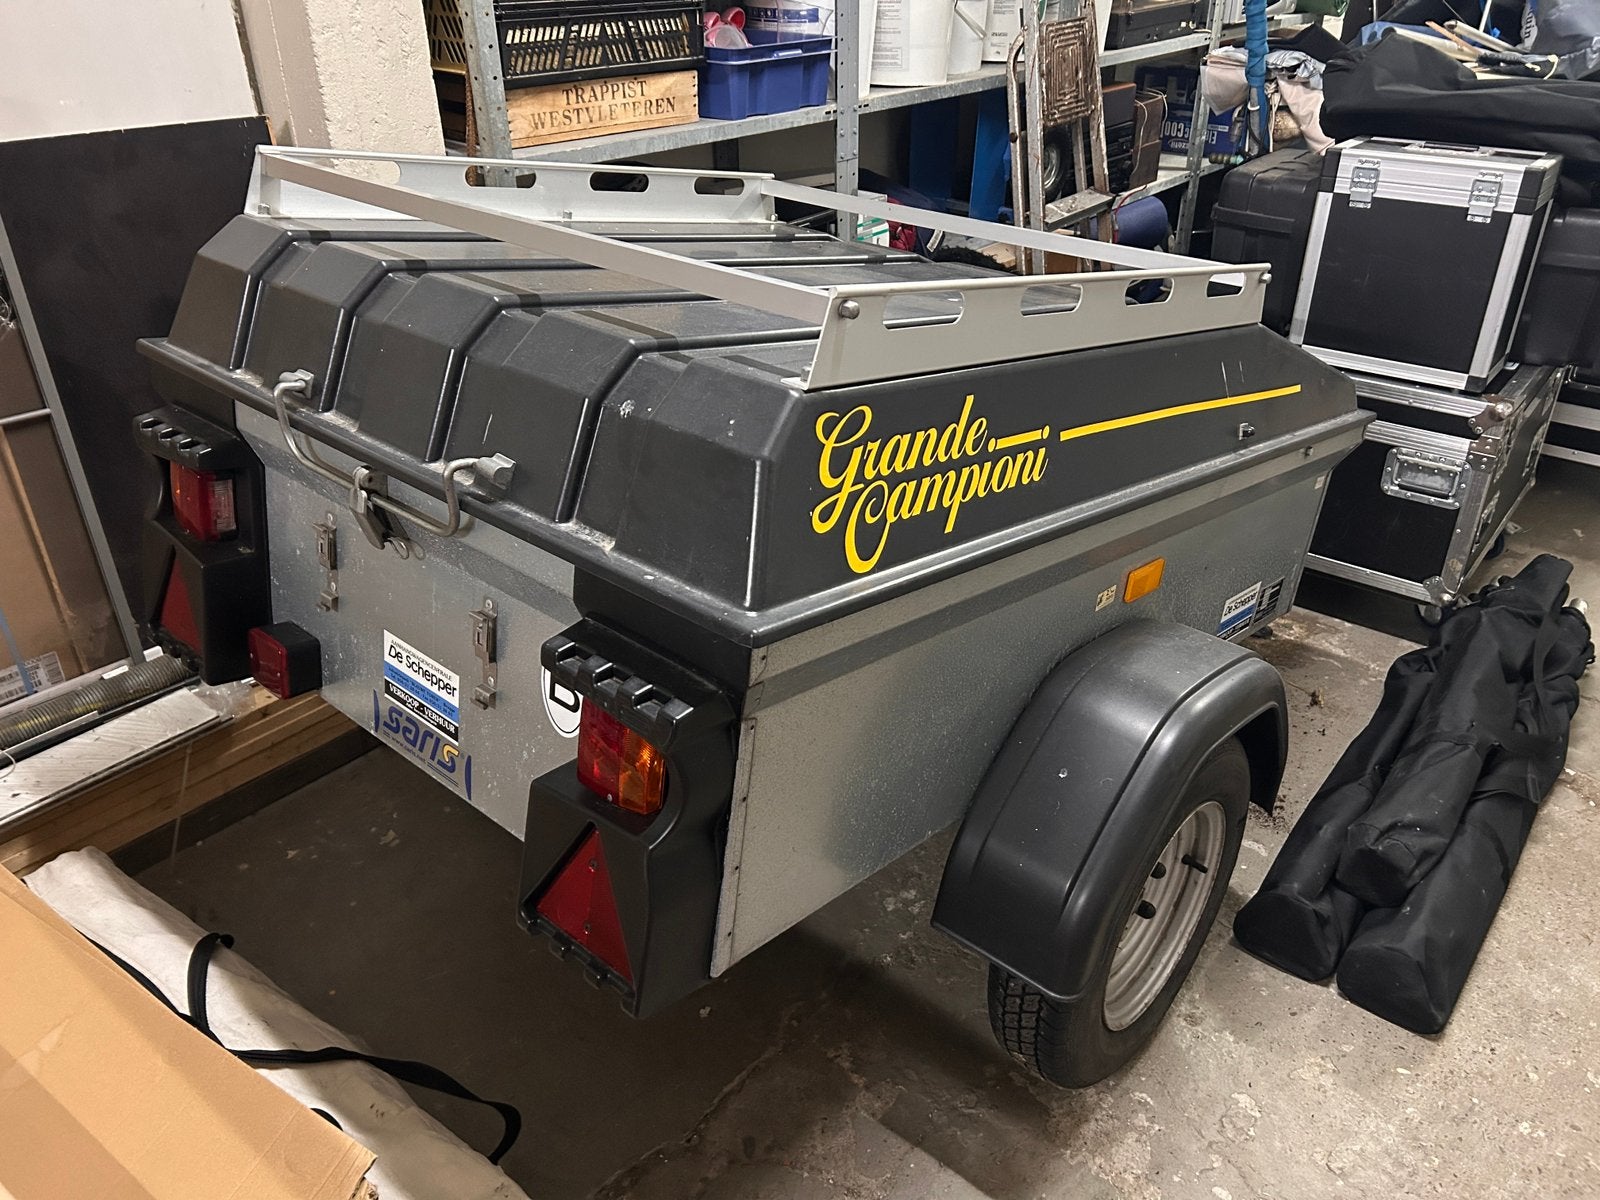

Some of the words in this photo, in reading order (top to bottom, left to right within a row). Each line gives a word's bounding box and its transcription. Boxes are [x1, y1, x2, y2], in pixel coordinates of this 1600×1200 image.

[531, 97, 676, 130] WESTVLETEREN
[562, 80, 647, 105] TRAPPIST
[811, 395, 988, 533] Grande
[845, 425, 1050, 573] Campioni
[389, 645, 403, 663] De
[405, 655, 457, 697] Schepper
[389, 684, 420, 708] VERKOOP
[424, 706, 455, 733] VERHUUR
[383, 705, 460, 774] saris
